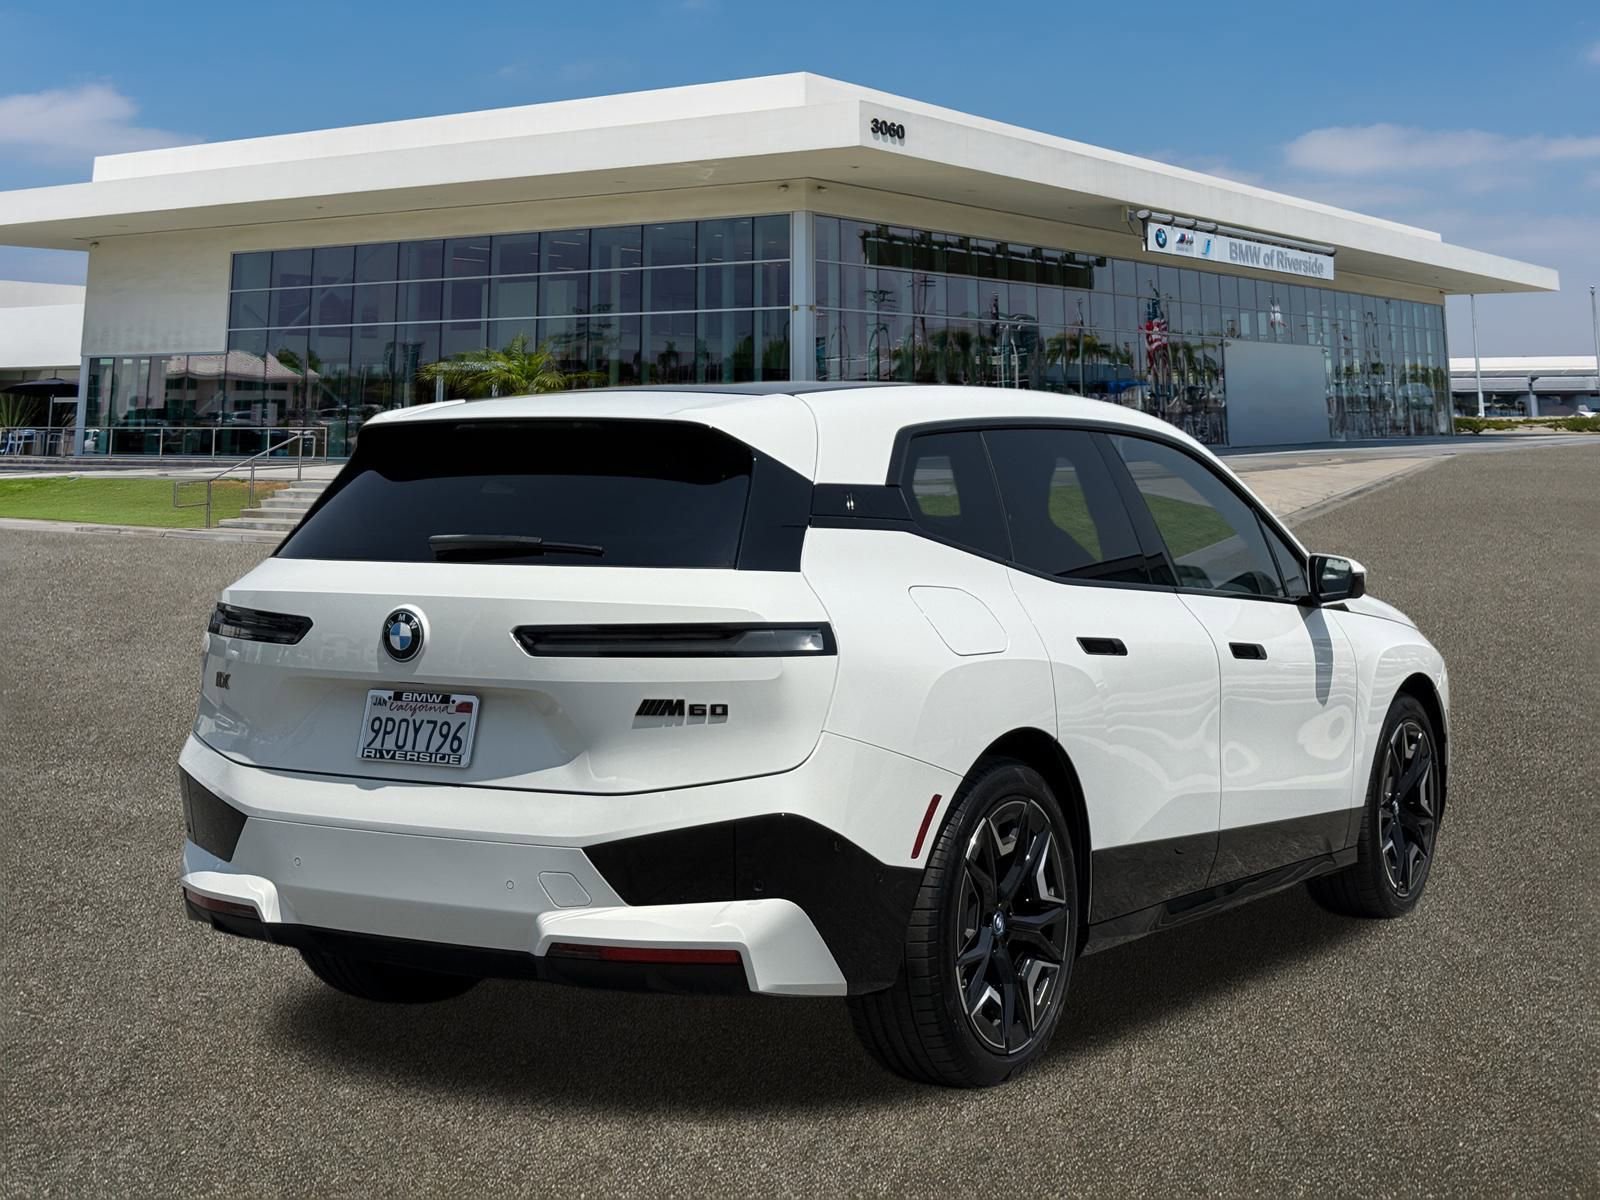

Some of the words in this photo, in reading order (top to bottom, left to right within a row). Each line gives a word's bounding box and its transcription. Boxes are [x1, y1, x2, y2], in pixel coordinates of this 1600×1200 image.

[871, 118, 905, 139] 3060
[1229, 242, 1261, 265] BMW
[1263, 252, 1275, 267] of
[1276, 251, 1324, 275] Riverside
[402, 692, 442, 703] BMW
[363, 748, 460, 765] RIVERSIDE
